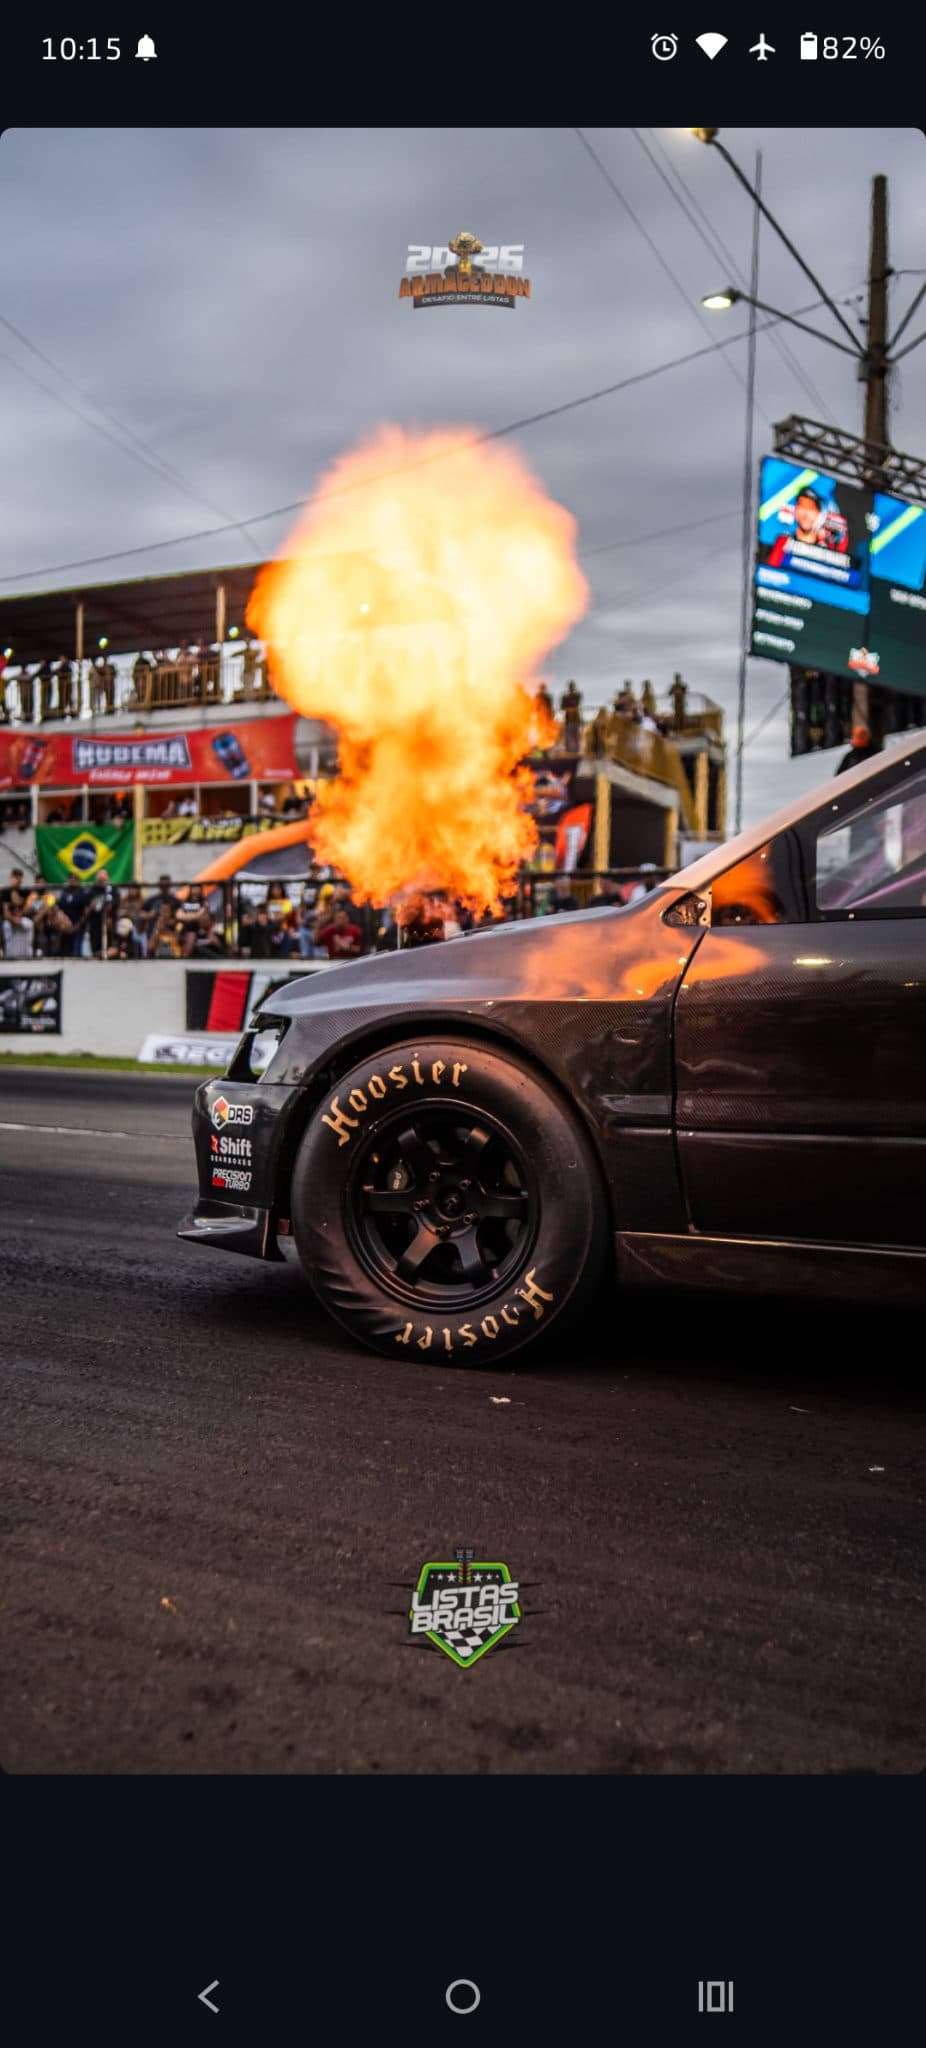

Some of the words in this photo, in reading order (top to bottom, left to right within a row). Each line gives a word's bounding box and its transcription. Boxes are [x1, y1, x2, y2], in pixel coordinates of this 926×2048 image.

[43, 38, 120, 60] 10:15
[823, 37, 885, 59] 82%
[322, 1052, 468, 1147] Hoosier
[228, 1107, 252, 1123] DRS
[219, 1136, 253, 1157] Shift
[210, 1155, 252, 1166] GEARBOXES
[224, 1179, 250, 1191] TURBO
[396, 1267, 554, 1358] Hoosier
